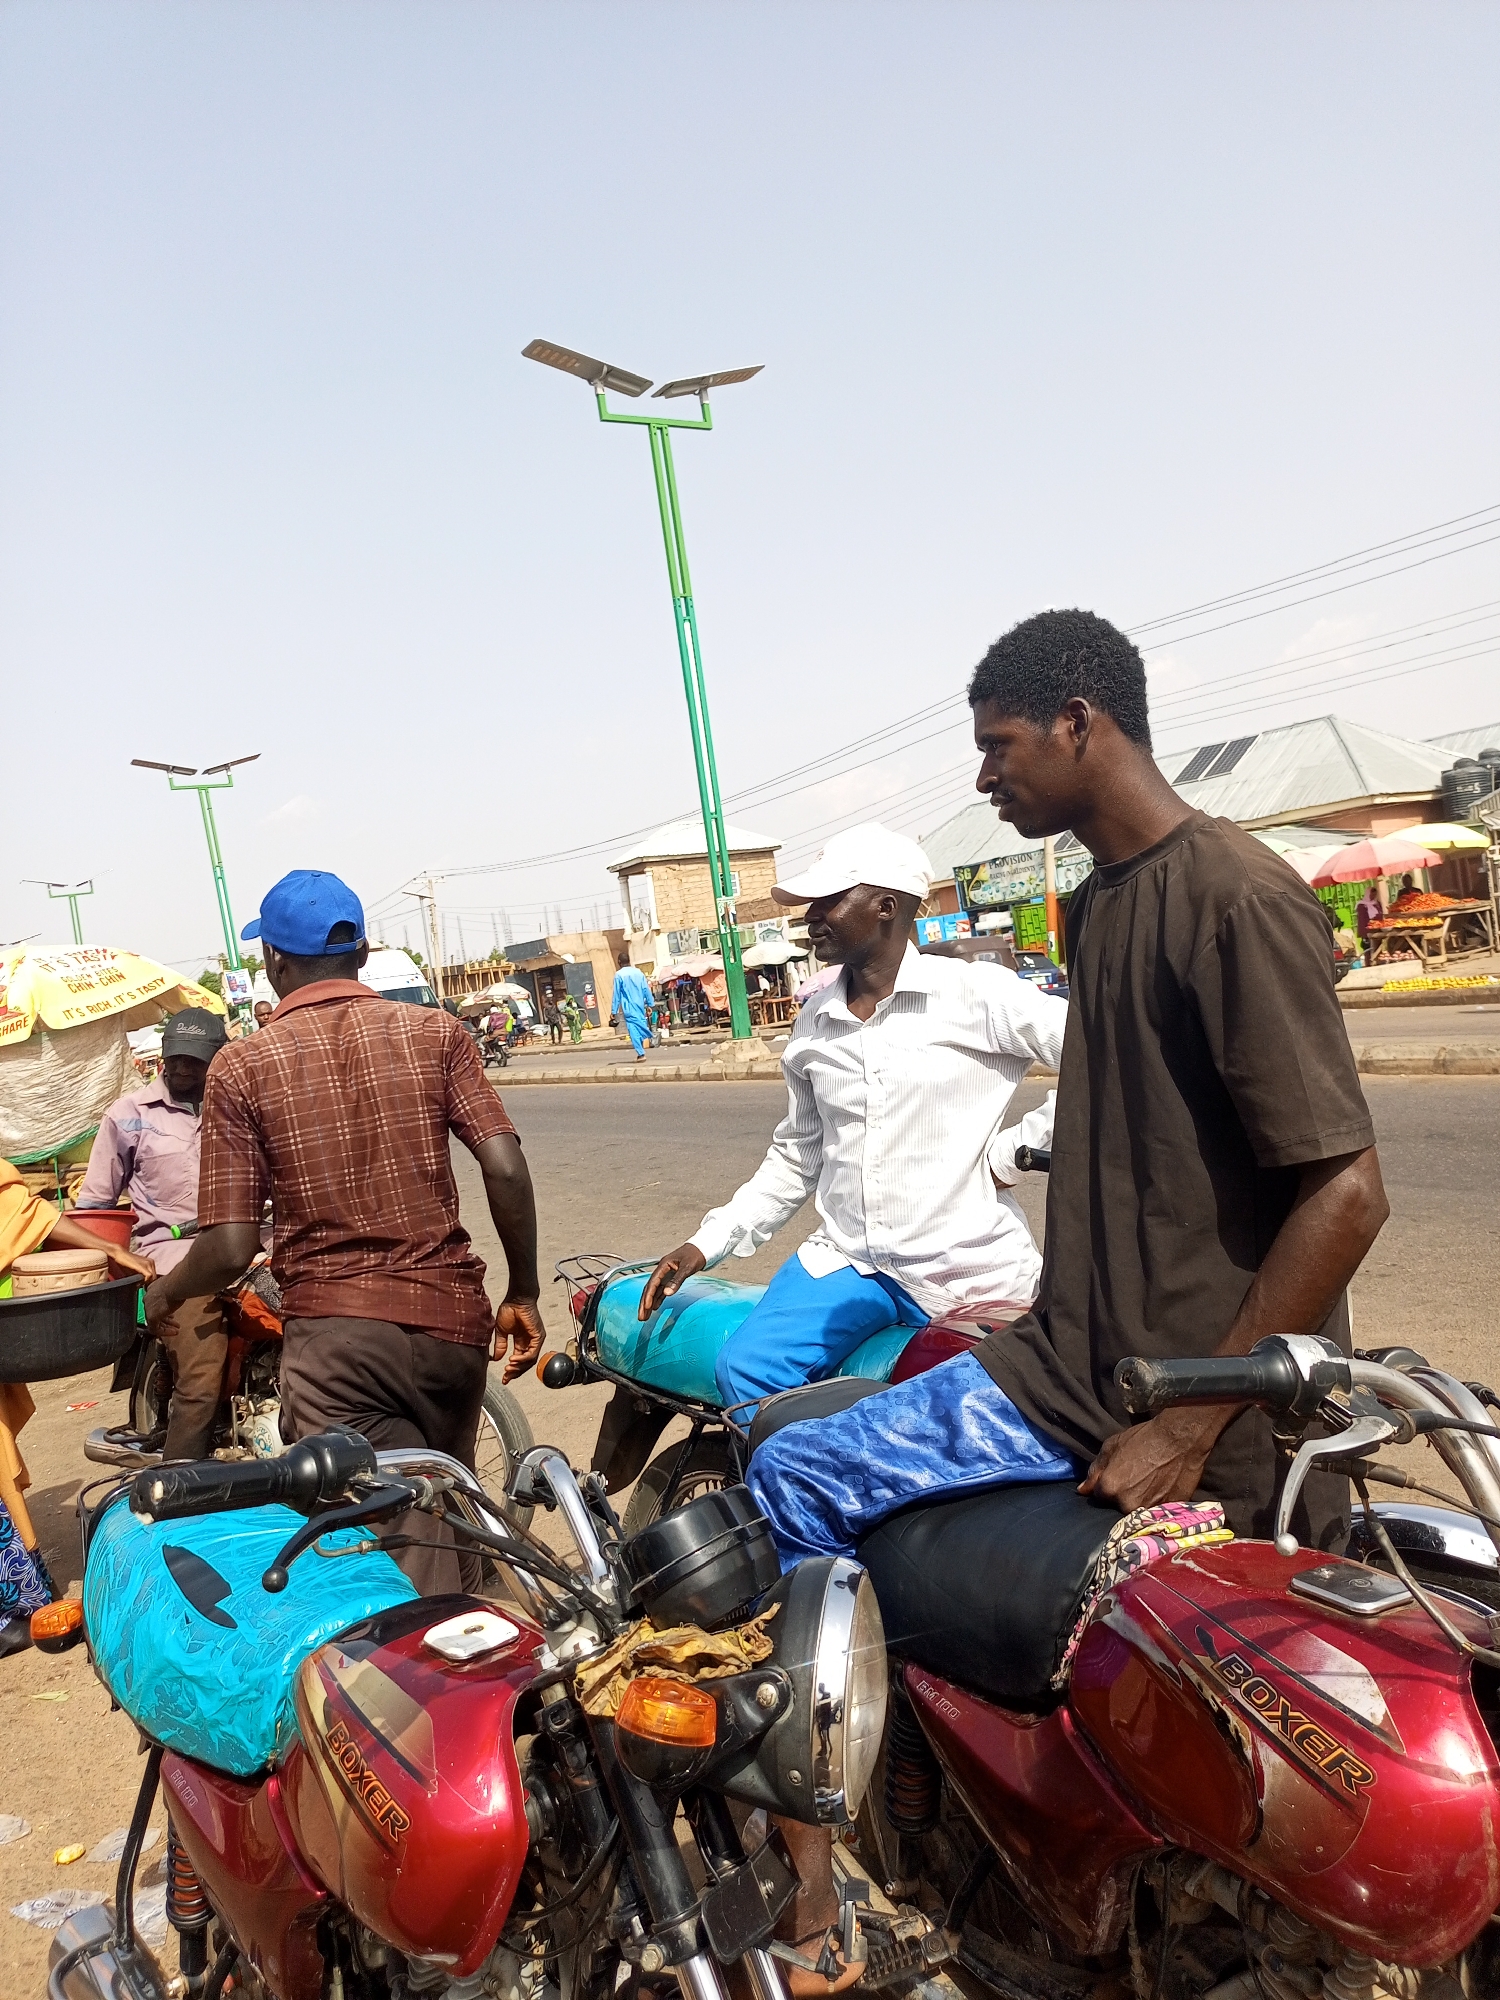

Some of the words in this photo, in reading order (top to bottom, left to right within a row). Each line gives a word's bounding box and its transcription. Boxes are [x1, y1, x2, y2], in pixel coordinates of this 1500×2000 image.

[989, 853, 1033, 869] PROVISION
[94, 966, 119, 977] BITES
[62, 1007, 86, 1021] IT'S
[113, 992, 137, 1006] IT'S
[136, 977, 166, 995] TASTY
[916, 1680, 940, 1701] BM
[936, 1697, 961, 1720] 100
[1211, 1652, 1374, 1795] BOXER
[180, 1786, 199, 1808] 100
[326, 1720, 411, 1842] BOXER
